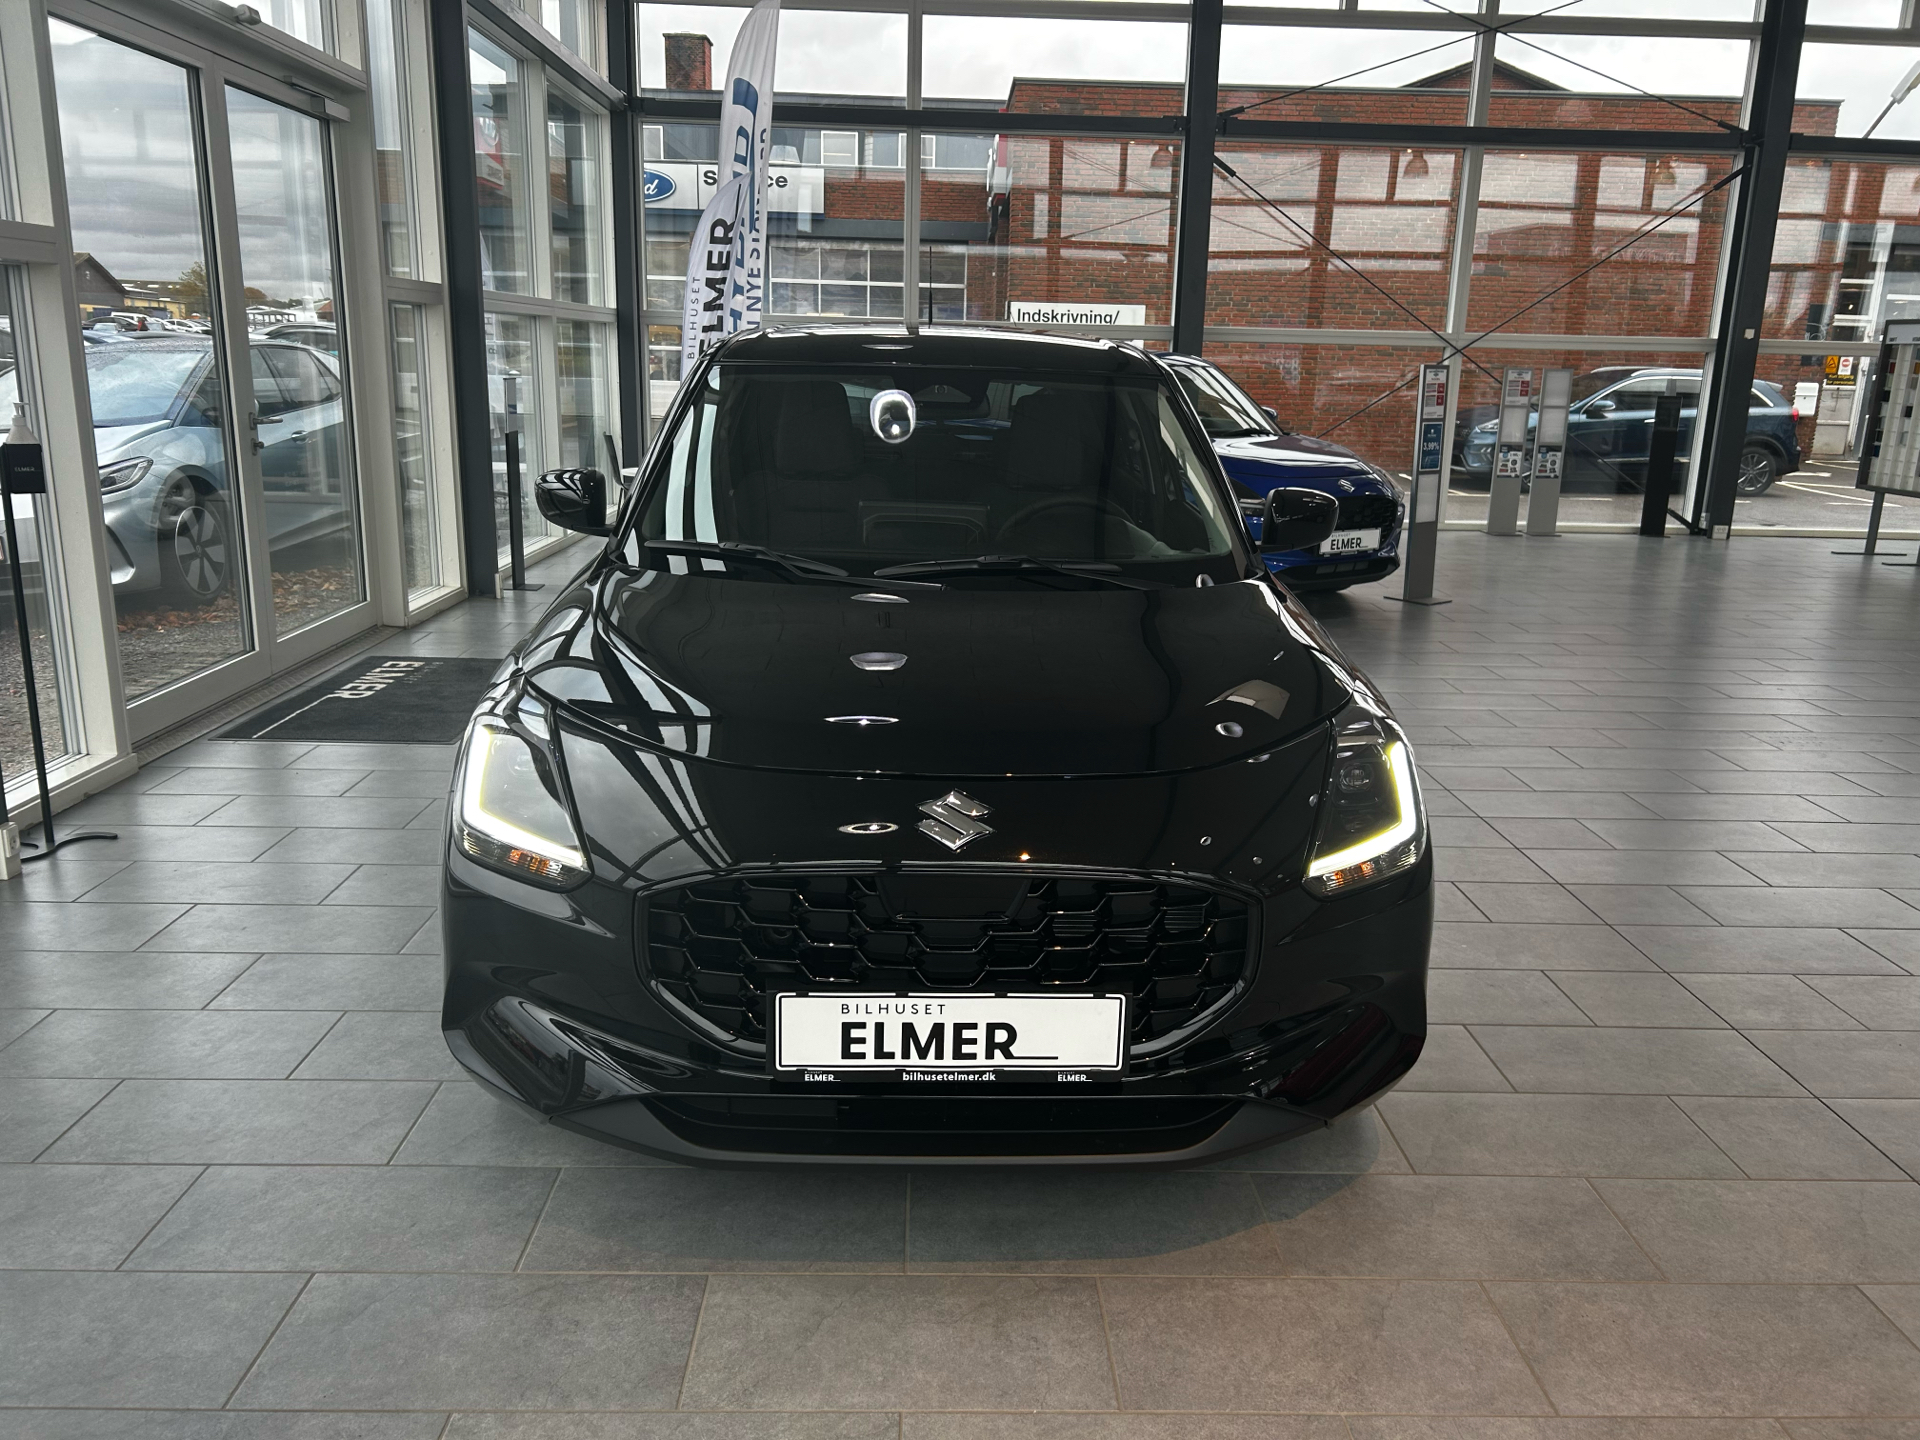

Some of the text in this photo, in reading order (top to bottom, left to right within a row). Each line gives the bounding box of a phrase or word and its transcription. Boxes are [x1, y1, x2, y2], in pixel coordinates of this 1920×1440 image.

[688, 277, 700, 359] BILHUSET
[1330, 537, 1362, 551] ELMER
[332, 661, 426, 699] ELMER
[841, 1003, 946, 1015] BILHUSET
[841, 1021, 1018, 1061] ELMER
[804, 1073, 835, 1082] ELMER
[902, 1072, 996, 1082] bilhusetelmer.dk
[1057, 1074, 1087, 1082] ELMER
